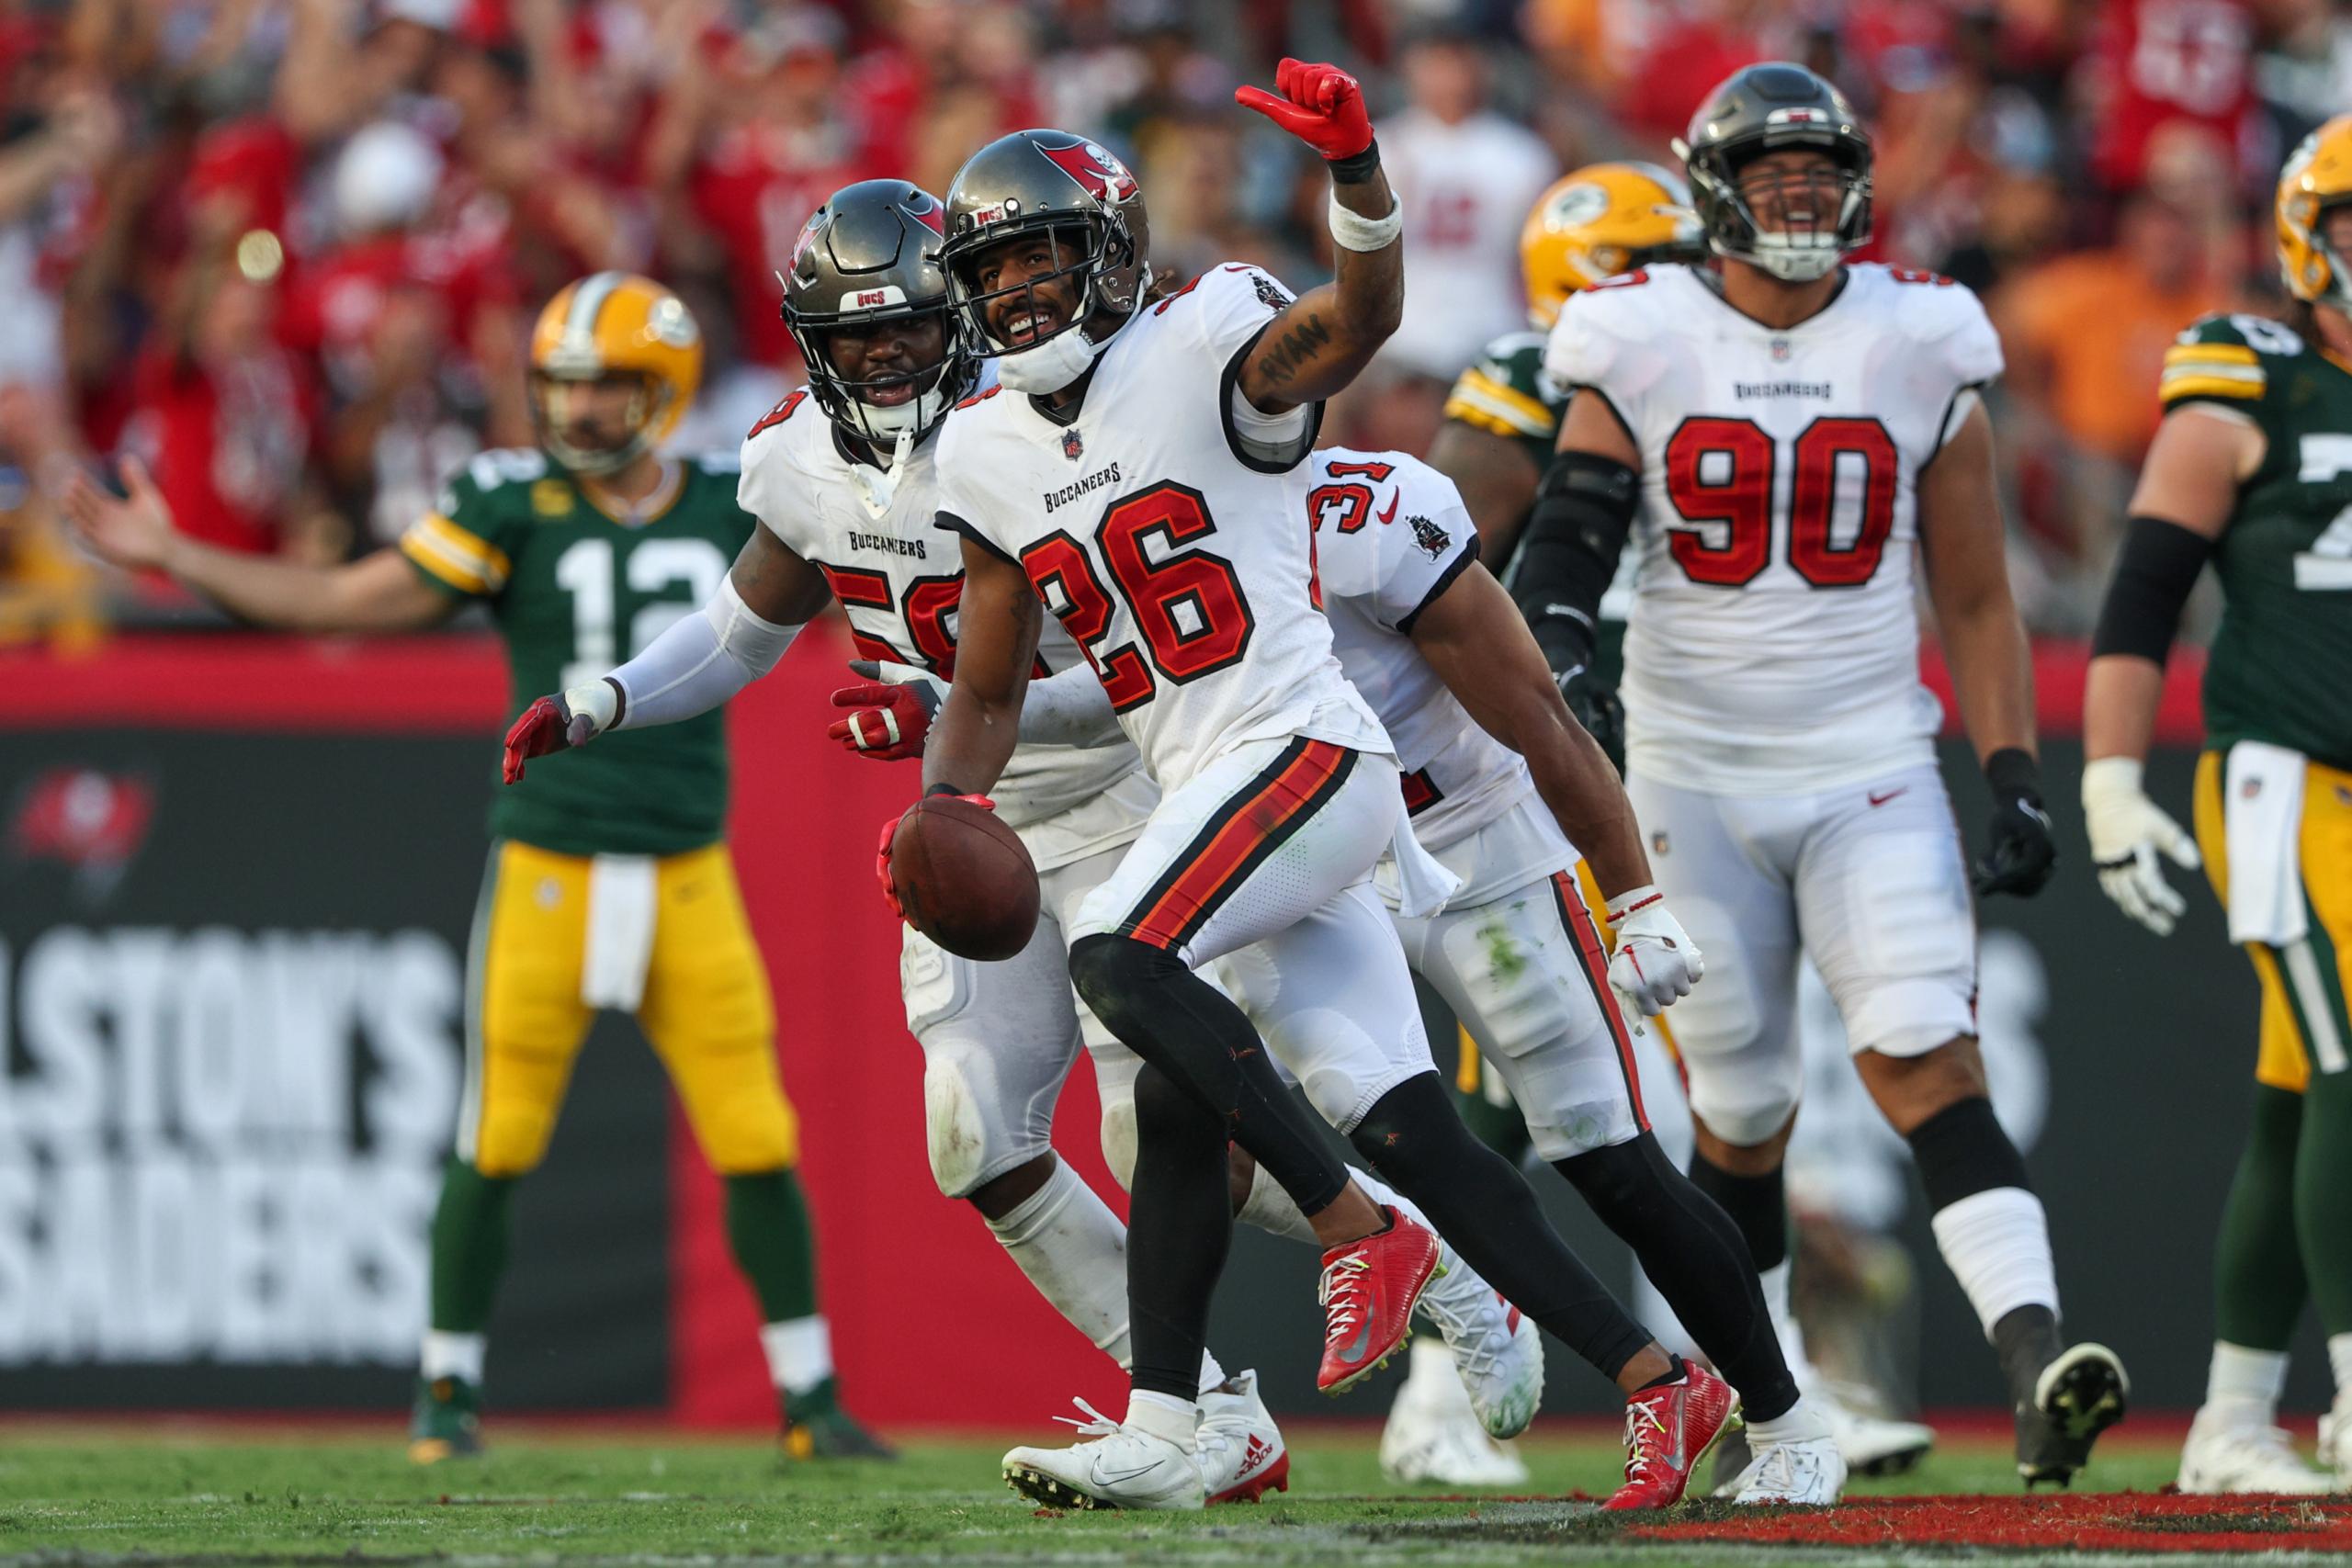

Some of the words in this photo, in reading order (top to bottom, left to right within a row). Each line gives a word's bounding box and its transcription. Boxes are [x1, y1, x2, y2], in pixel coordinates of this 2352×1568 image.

[1259, 313, 1329, 382] RYAN
[1043, 461, 1121, 513] BUCCANEERS
[1306, 460, 1396, 535] 31
[1665, 416, 1898, 588] 90
[848, 531, 927, 559] BUCCANEERS
[555, 537, 731, 694] 12
[1020, 479, 1255, 715] 26
